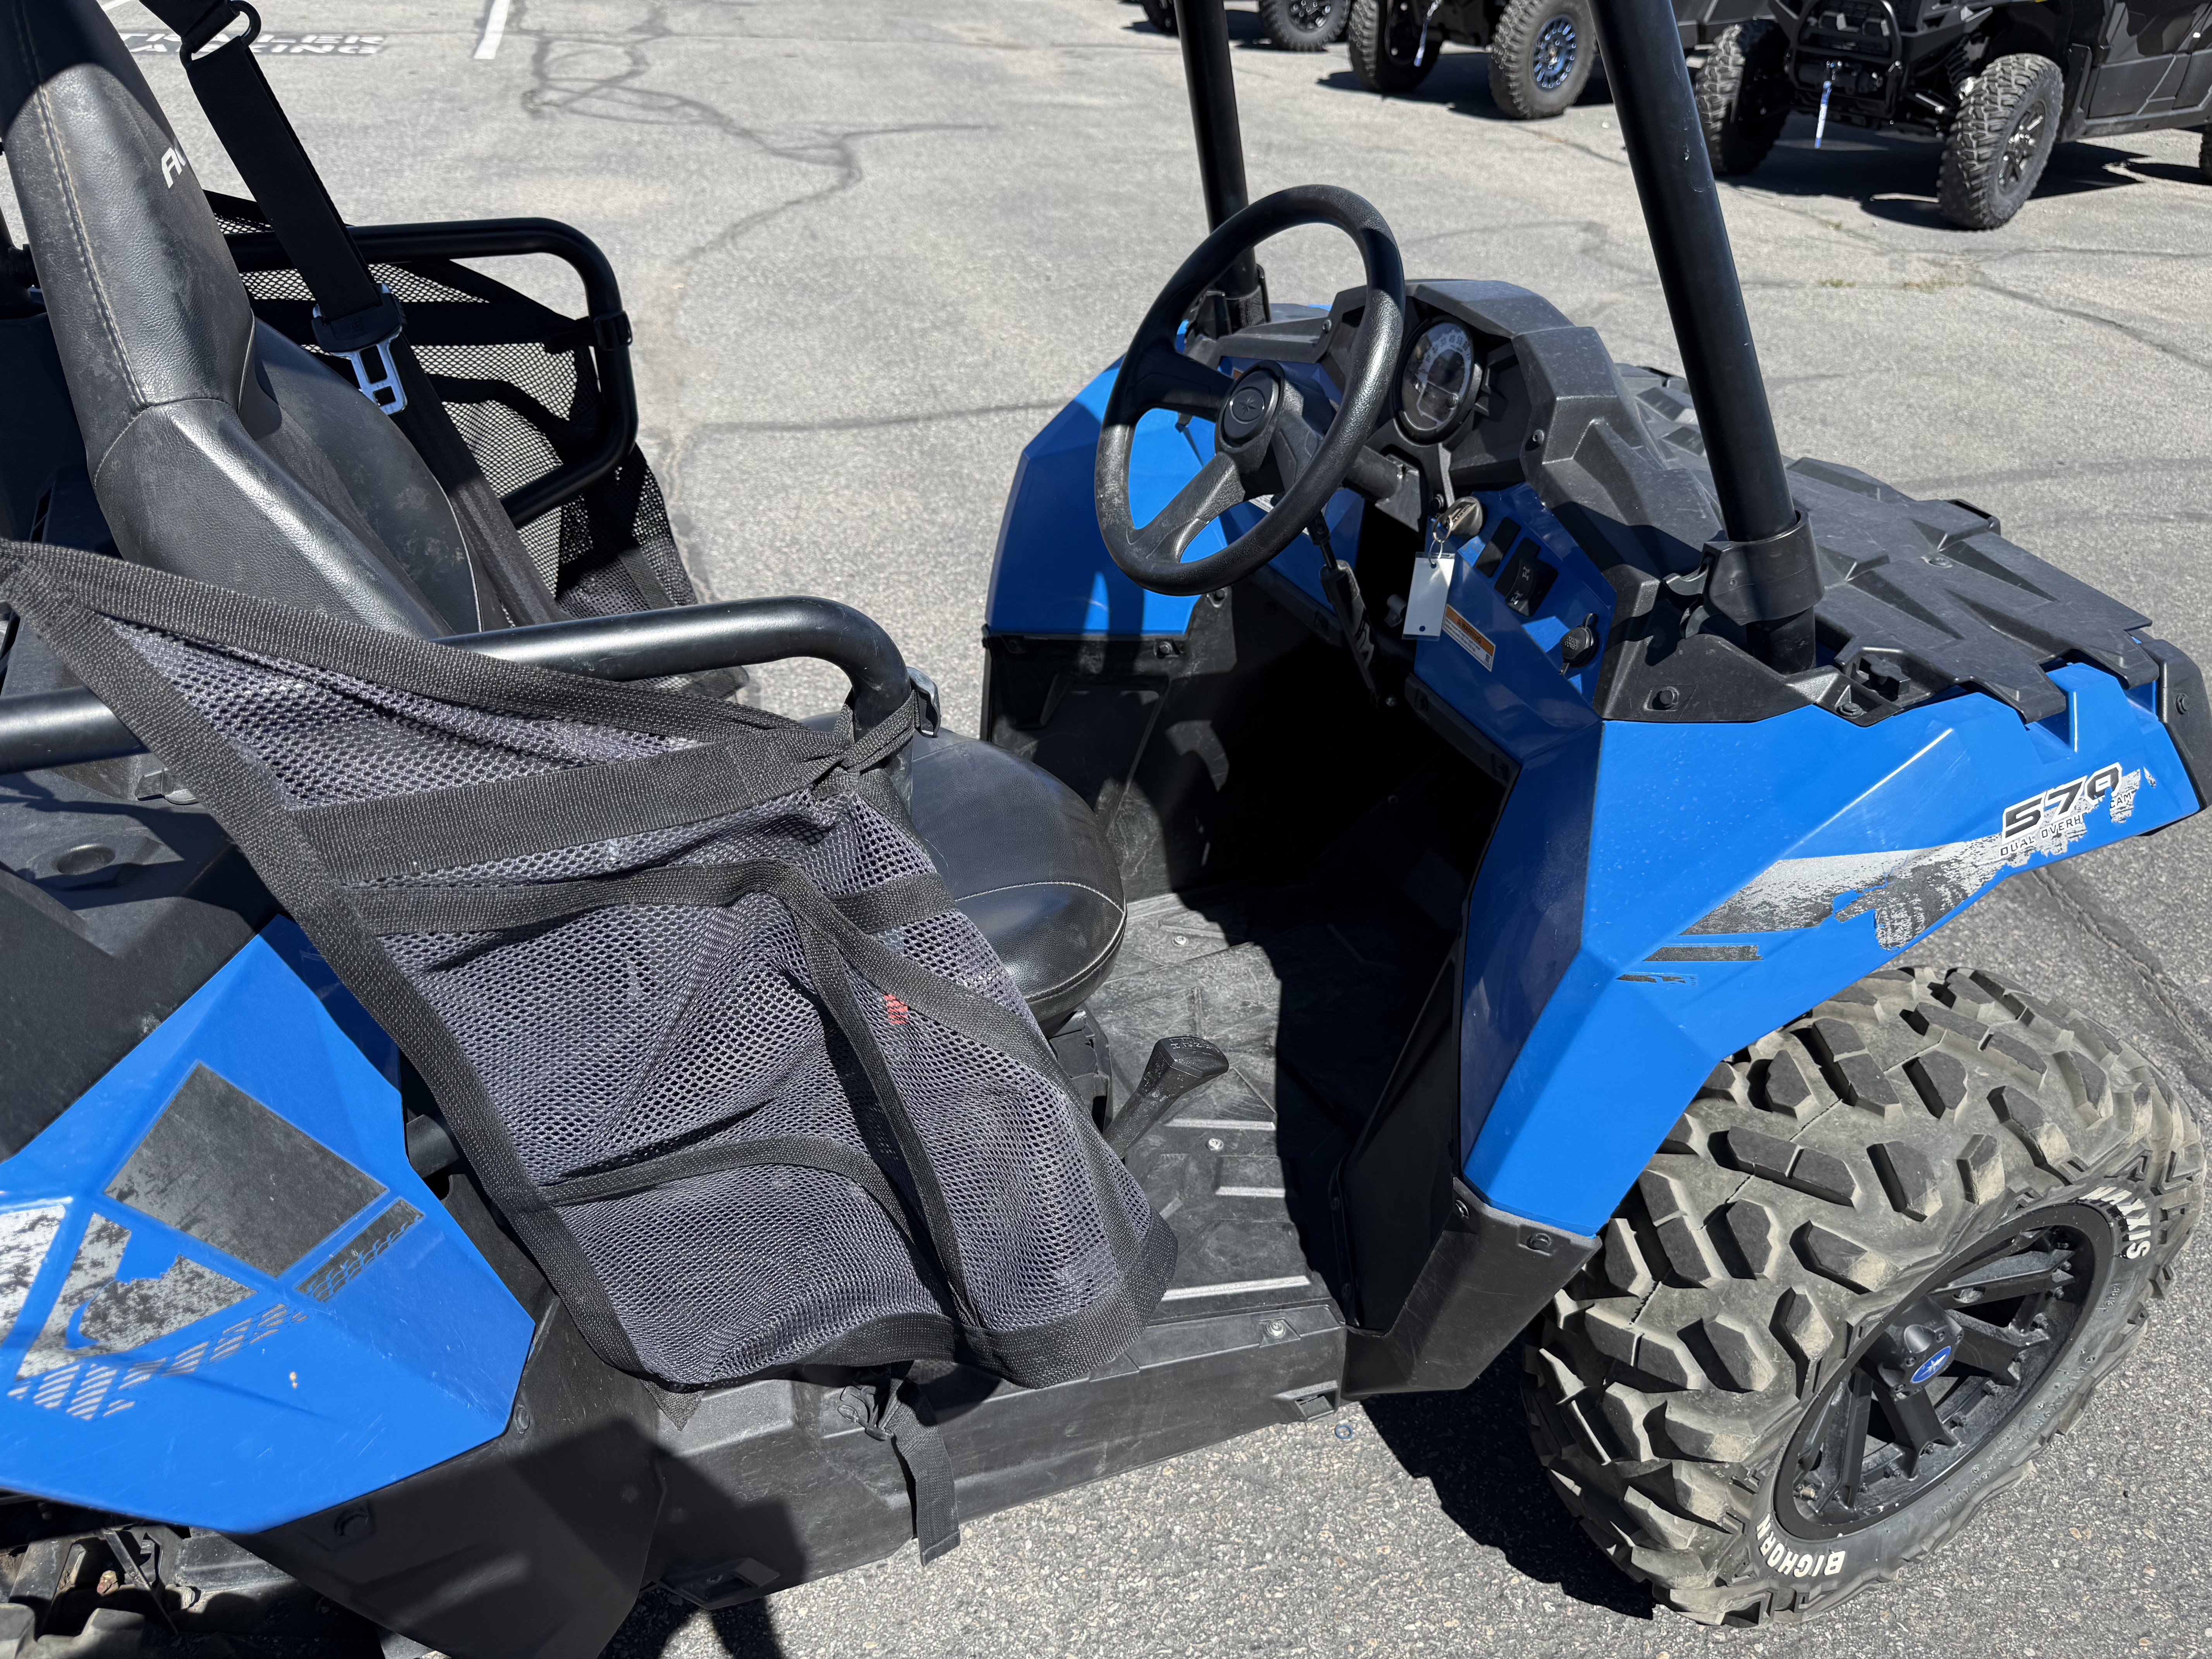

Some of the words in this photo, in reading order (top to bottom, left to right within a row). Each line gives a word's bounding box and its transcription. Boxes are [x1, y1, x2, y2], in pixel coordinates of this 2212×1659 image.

[1462, 622, 1482, 644] WARNING
[2000, 835, 2036, 857] DUAL
[2041, 814, 2083, 839] OVERH
[2110, 792, 2132, 809] CAM
[2078, 1187, 2151, 1259] MAXXIS
[1935, 1479, 1980, 1520] RADIAL
[1756, 1513, 1846, 1578] BIGHORN
